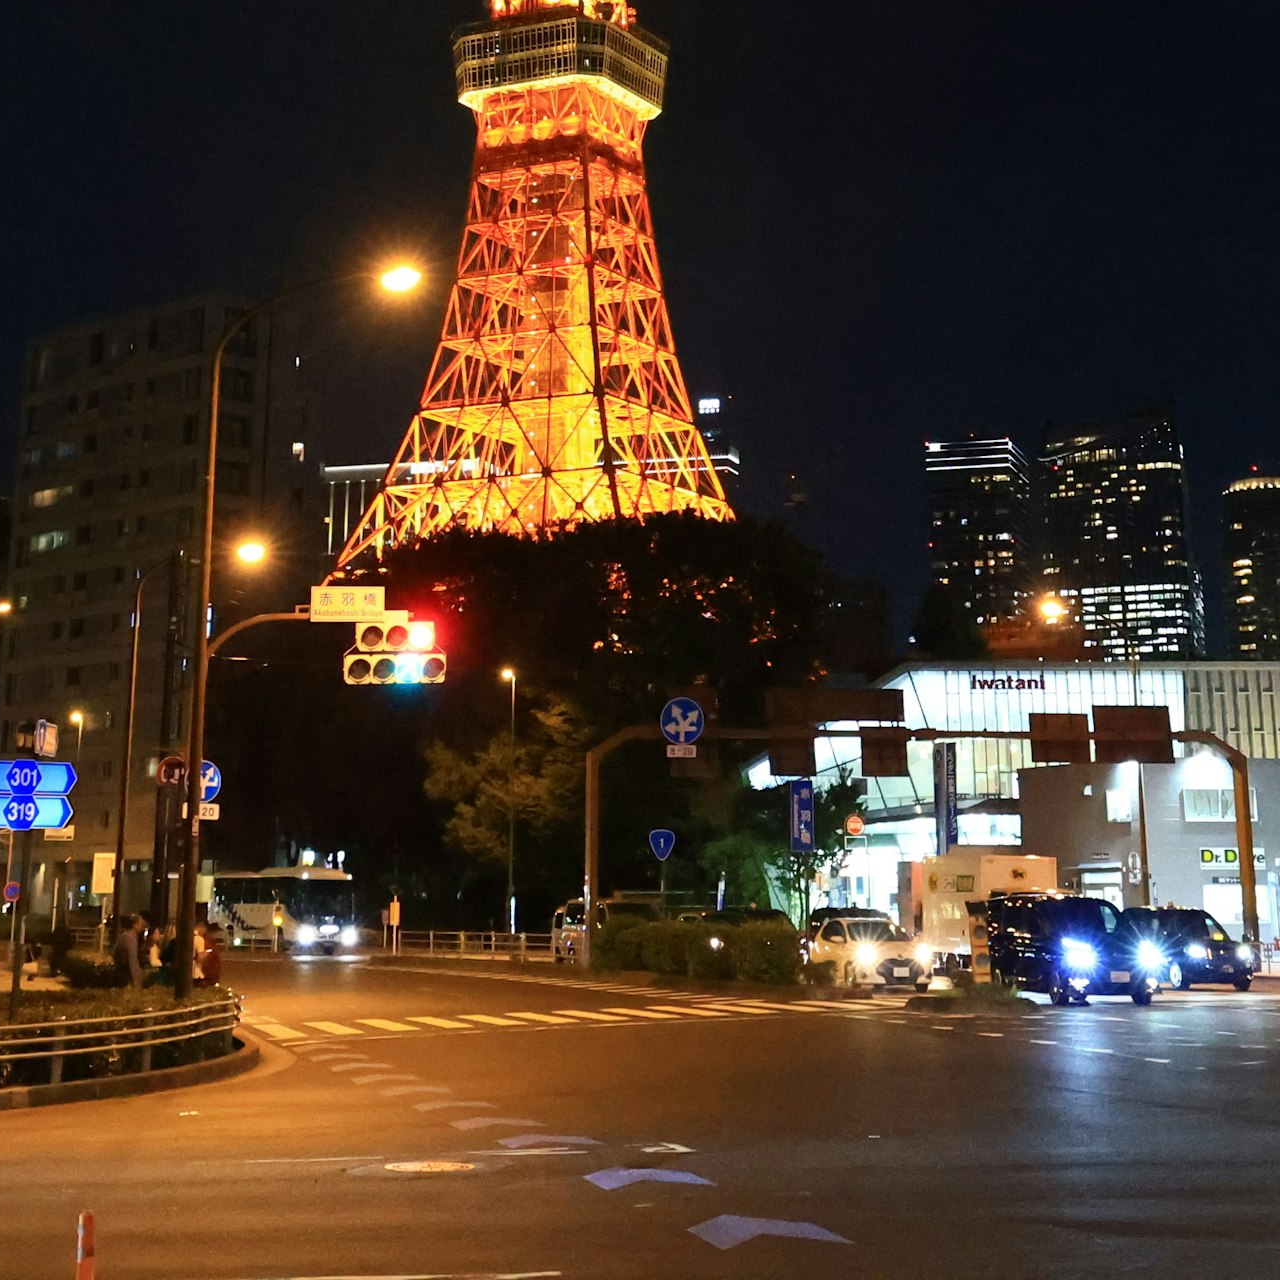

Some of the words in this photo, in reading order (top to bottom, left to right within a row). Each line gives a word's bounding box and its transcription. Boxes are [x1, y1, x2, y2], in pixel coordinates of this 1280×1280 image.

[319, 592, 377, 606] 赤羽橋
[971, 675, 1045, 690] Iwatani
[10, 768, 38, 786] 301
[7, 802, 35, 821] 319
[1200, 849, 1222, 864] Dr.
